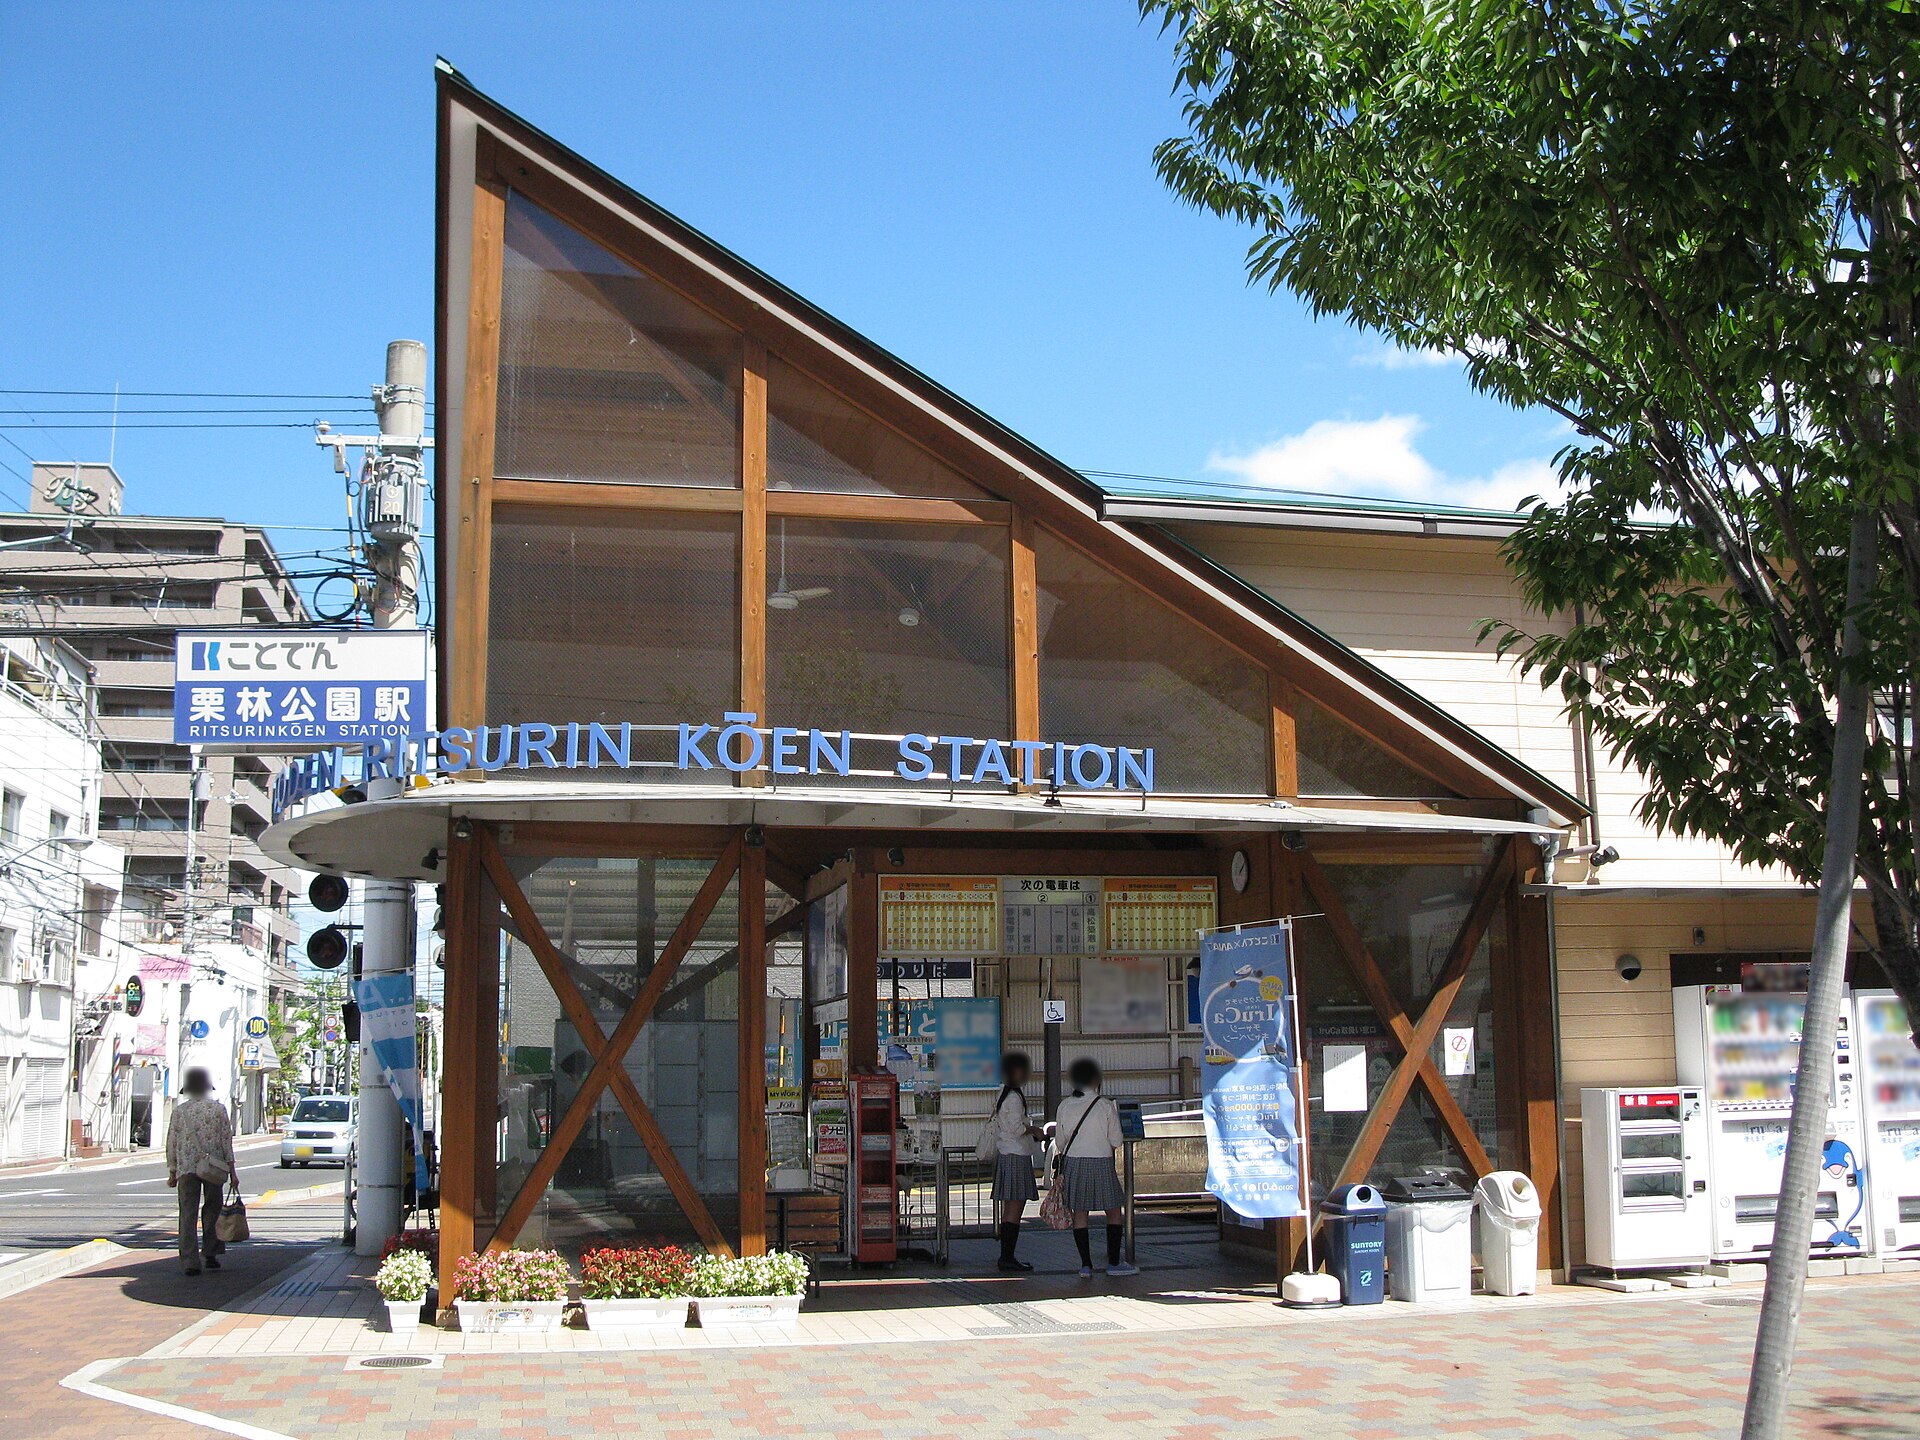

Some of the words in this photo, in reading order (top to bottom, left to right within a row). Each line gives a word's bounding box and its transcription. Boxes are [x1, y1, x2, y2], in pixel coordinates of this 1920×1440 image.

[228, 642, 338, 671] ことでん
[189, 686, 411, 723] 栗林公園駅
[189, 722, 327, 738] RITSURINKŌEN
[339, 724, 411, 738] STATION
[362, 721, 632, 783] RITSURIN
[678, 711, 851, 777] KŌEN
[897, 733, 1155, 792] STATION
[1020, 879, 1080, 891] 次の電車は
[1743, 1121, 1783, 1135] IruCa
[1350, 1241, 1383, 1249] SUNTORY
